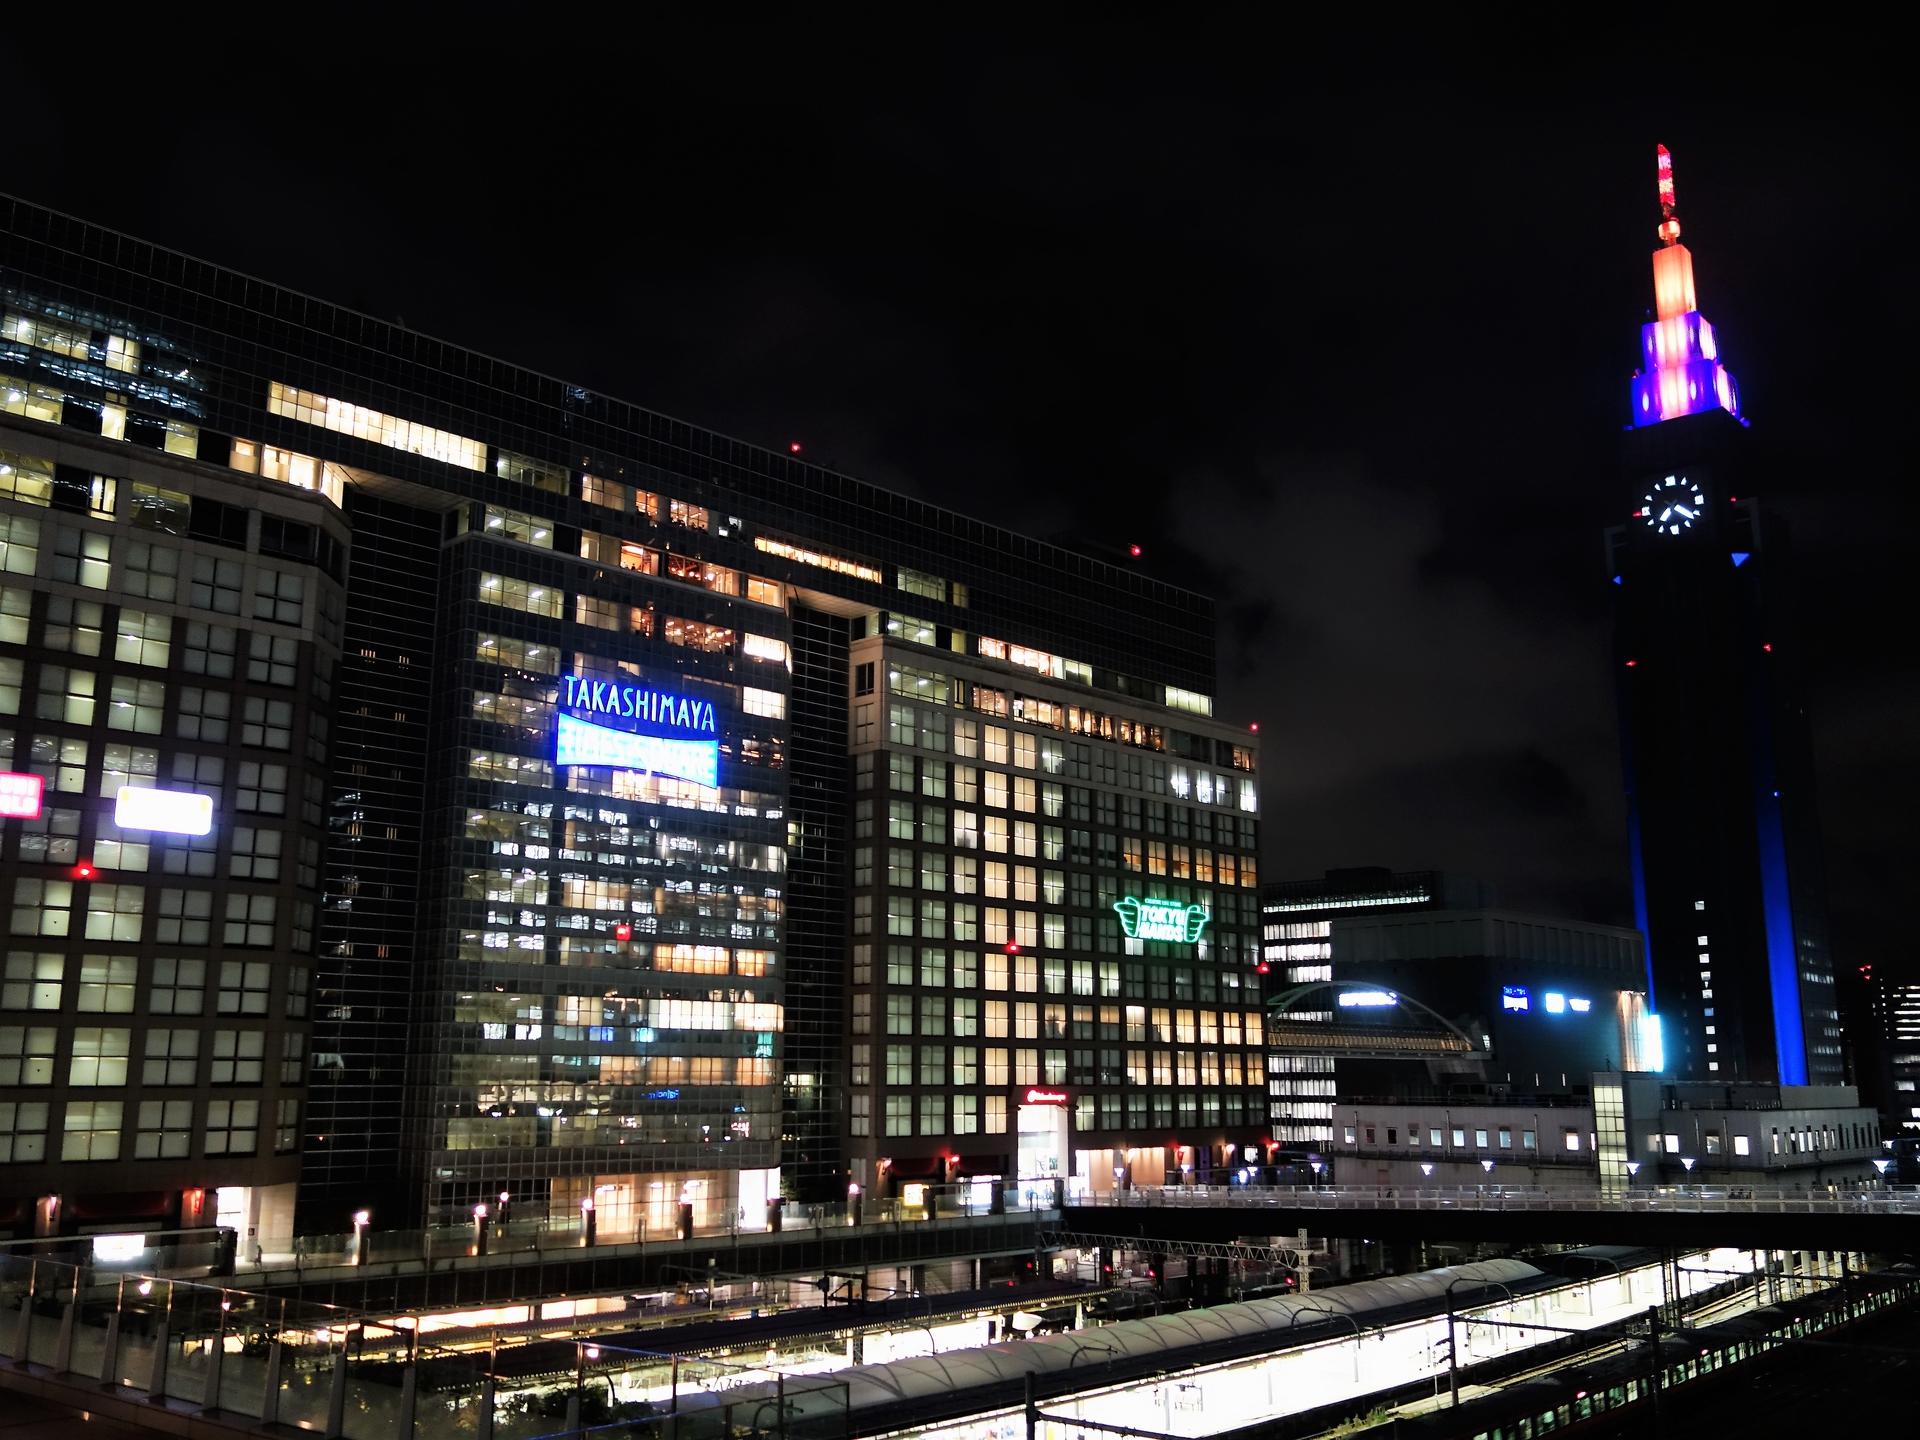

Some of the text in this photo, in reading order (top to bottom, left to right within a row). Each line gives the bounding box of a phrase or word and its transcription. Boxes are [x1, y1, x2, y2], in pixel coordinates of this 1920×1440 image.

[565, 675, 714, 732] TAKASHIMAYA
[0, 776, 36, 796] UNI
[1141, 905, 1185, 925] TOKYU
[1139, 922, 1183, 942] HANDS
